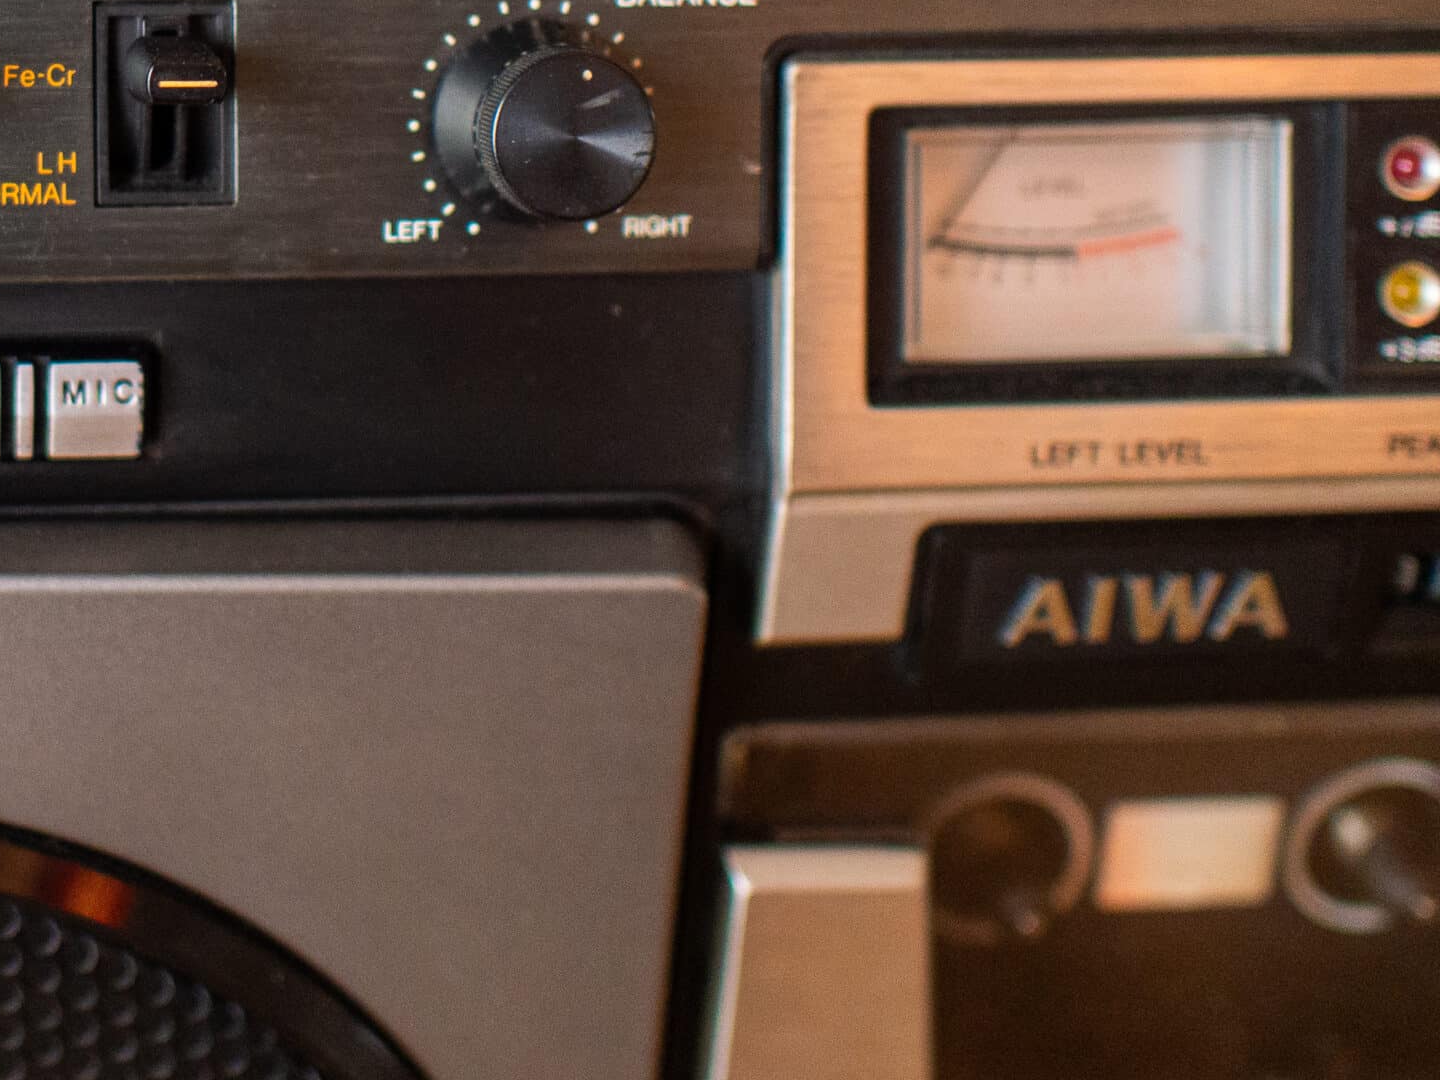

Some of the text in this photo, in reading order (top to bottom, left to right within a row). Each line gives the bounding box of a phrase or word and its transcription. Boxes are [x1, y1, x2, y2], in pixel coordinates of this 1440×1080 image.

[3, 63, 77, 88] Fe-Cr
[382, 219, 443, 243] LEFT
[623, 214, 693, 238] RIGHT
[62, 377, 137, 405] MIC
[1028, 438, 1212, 469] LEFT LEVEL
[998, 570, 1288, 648] AIWA
